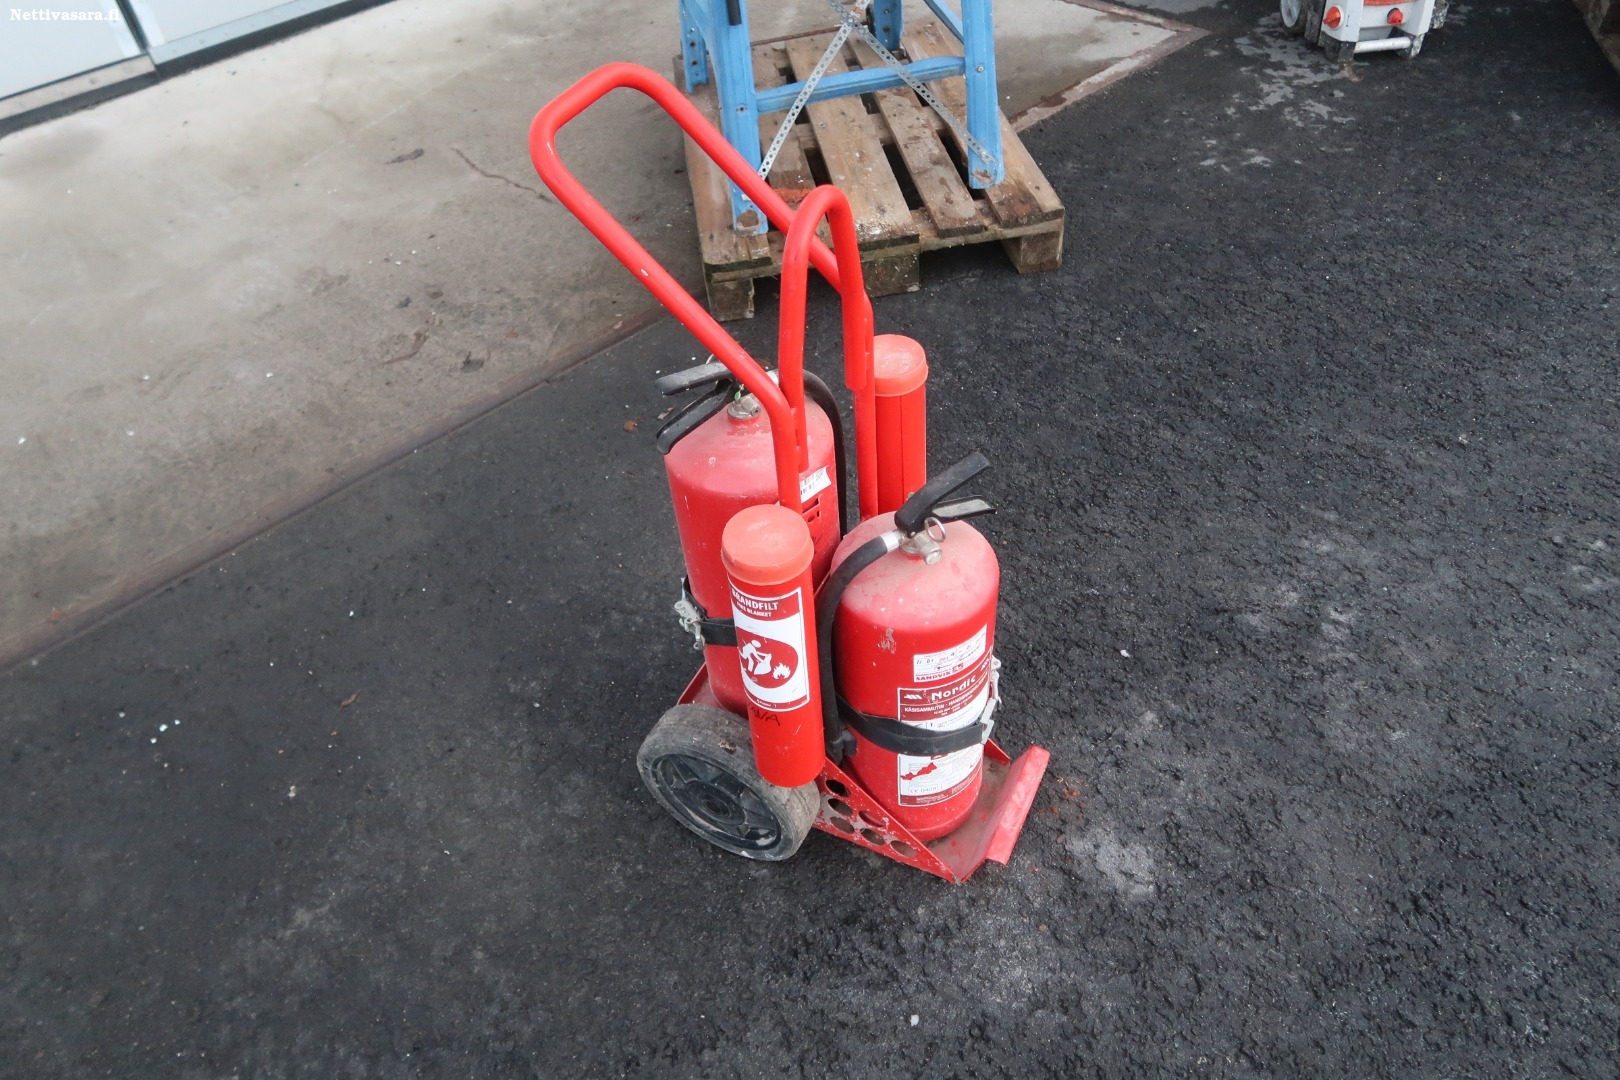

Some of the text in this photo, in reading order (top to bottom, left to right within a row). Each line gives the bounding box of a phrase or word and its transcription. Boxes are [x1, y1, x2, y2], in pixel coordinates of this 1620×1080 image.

[731, 587, 779, 611] BRANDFILT
[746, 607, 772, 617] BLANKET
[915, 671, 951, 681] SANDVIK
[931, 675, 976, 701] Nordic
[904, 703, 945, 713] KÄSISAMMUTIN
